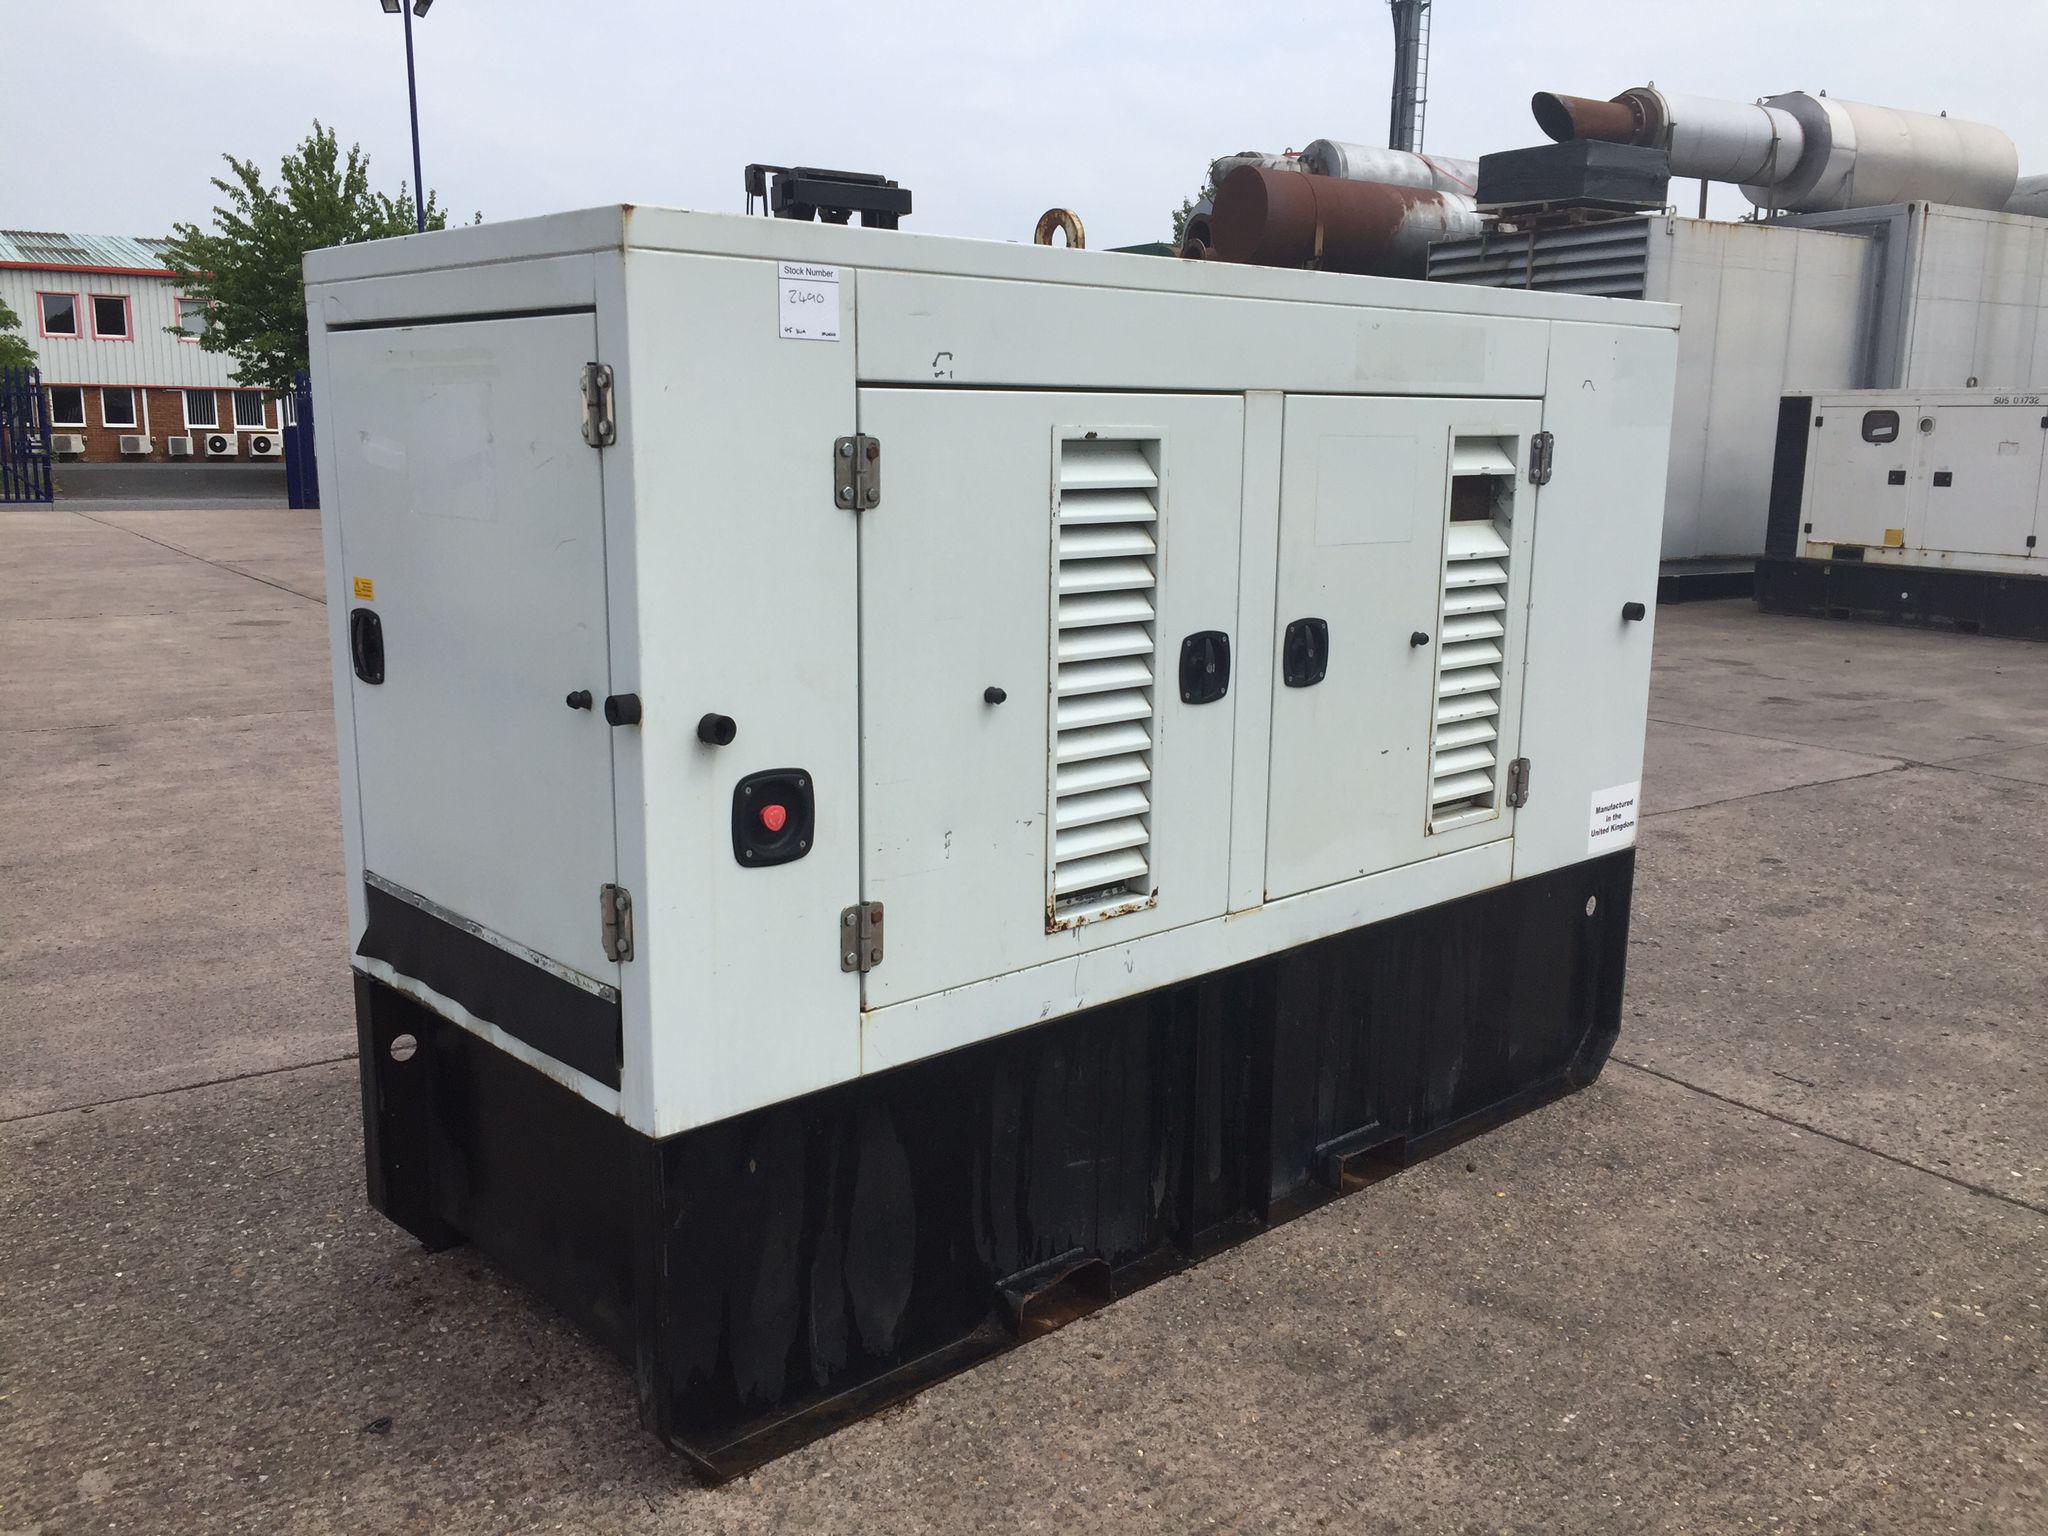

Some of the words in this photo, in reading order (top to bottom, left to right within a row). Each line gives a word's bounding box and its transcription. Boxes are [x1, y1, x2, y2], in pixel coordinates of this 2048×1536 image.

[784, 265, 804, 276] Stock
[805, 267, 834, 278] Number
[788, 289, 825, 304] 2490
[1595, 798, 1634, 814] Manufactured
[1612, 813, 1622, 821] the
[1590, 825, 1610, 837] United
[1610, 820, 1635, 832] Kingdom
